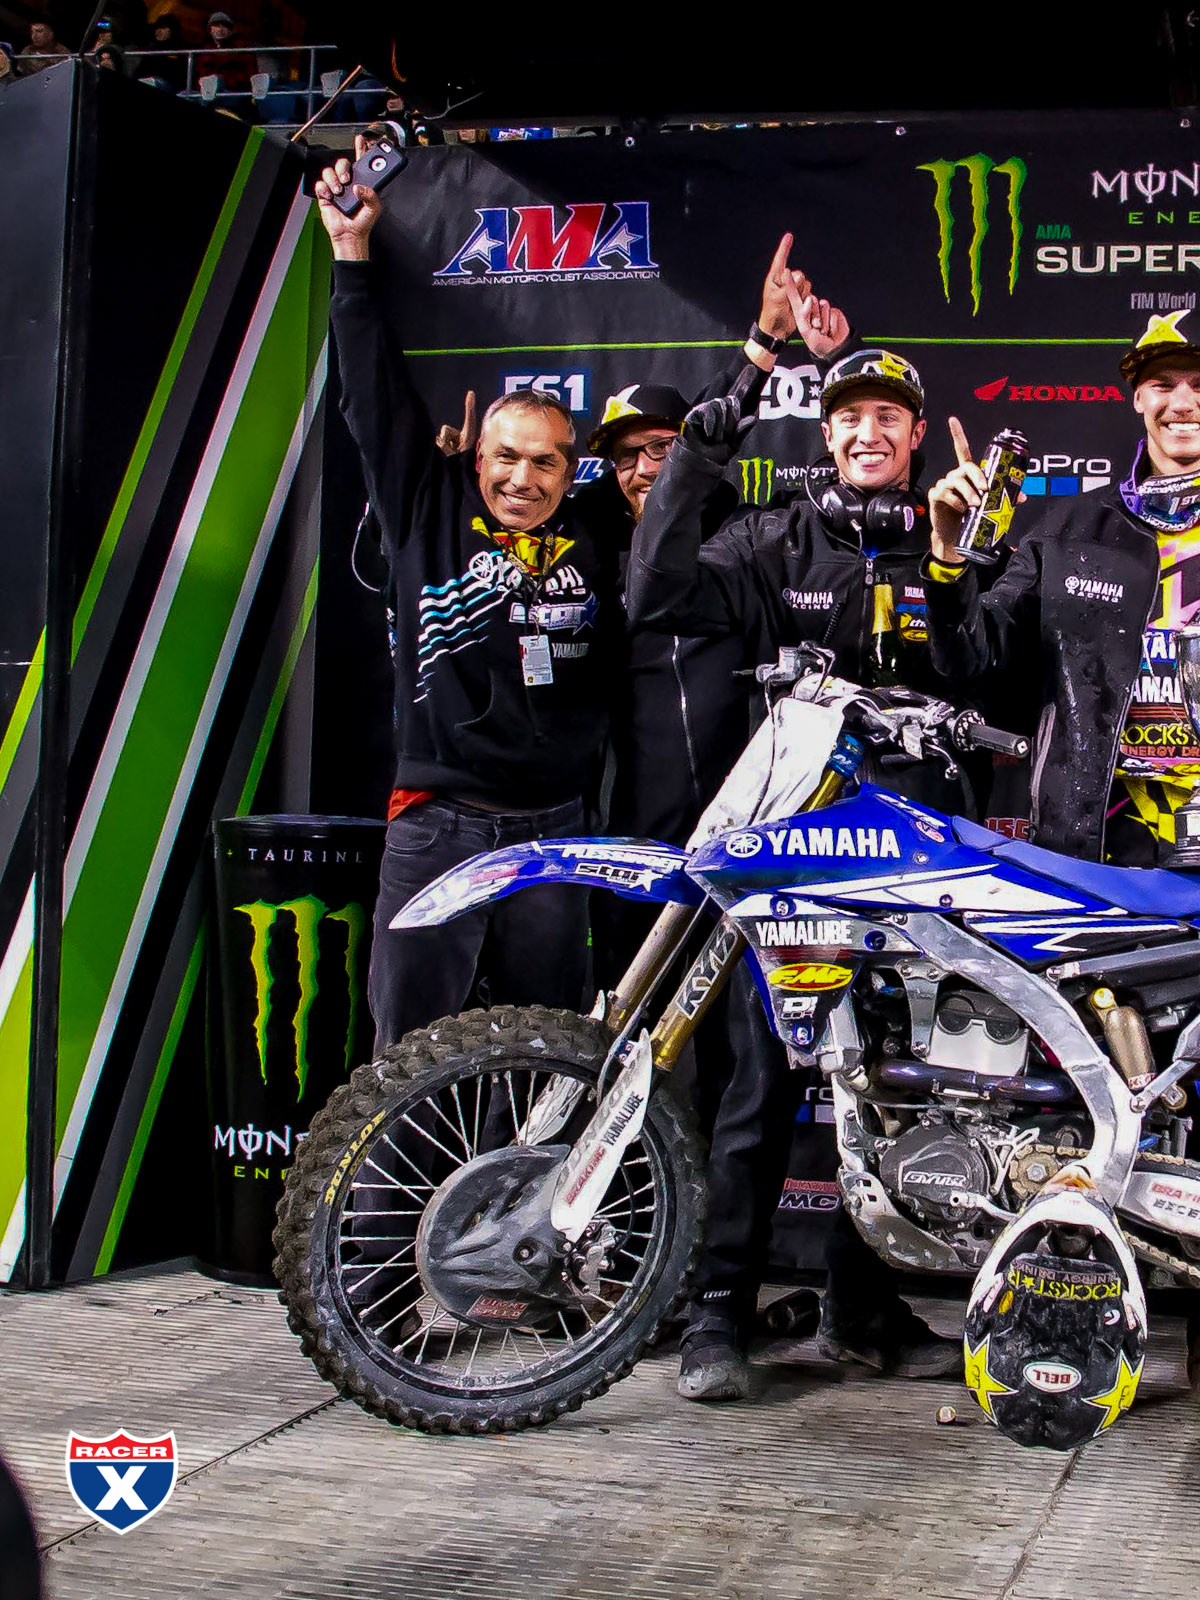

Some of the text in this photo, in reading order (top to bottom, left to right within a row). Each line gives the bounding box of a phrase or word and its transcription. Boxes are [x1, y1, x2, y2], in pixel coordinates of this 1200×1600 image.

[433, 202, 659, 276] AMA
[1036, 224, 1072, 239] AMA
[432, 271, 660, 286] AMERICAN MOTORCYCLIST ASSOCIATION
[1131, 293, 1154, 309] FIM
[1157, 292, 1196, 309] World
[1008, 385, 1125, 401] HONDA
[1080, 579, 1123, 598] YAMAHA
[792, 591, 833, 605] YAMAHA
[766, 828, 901, 858] YAMAHA
[755, 920, 853, 947] YAMALUBE
[600, 1090, 645, 1146] YAMALUBE
[324, 1107, 387, 1205] DUNLOP
[1032, 1369, 1072, 1385] BELL
